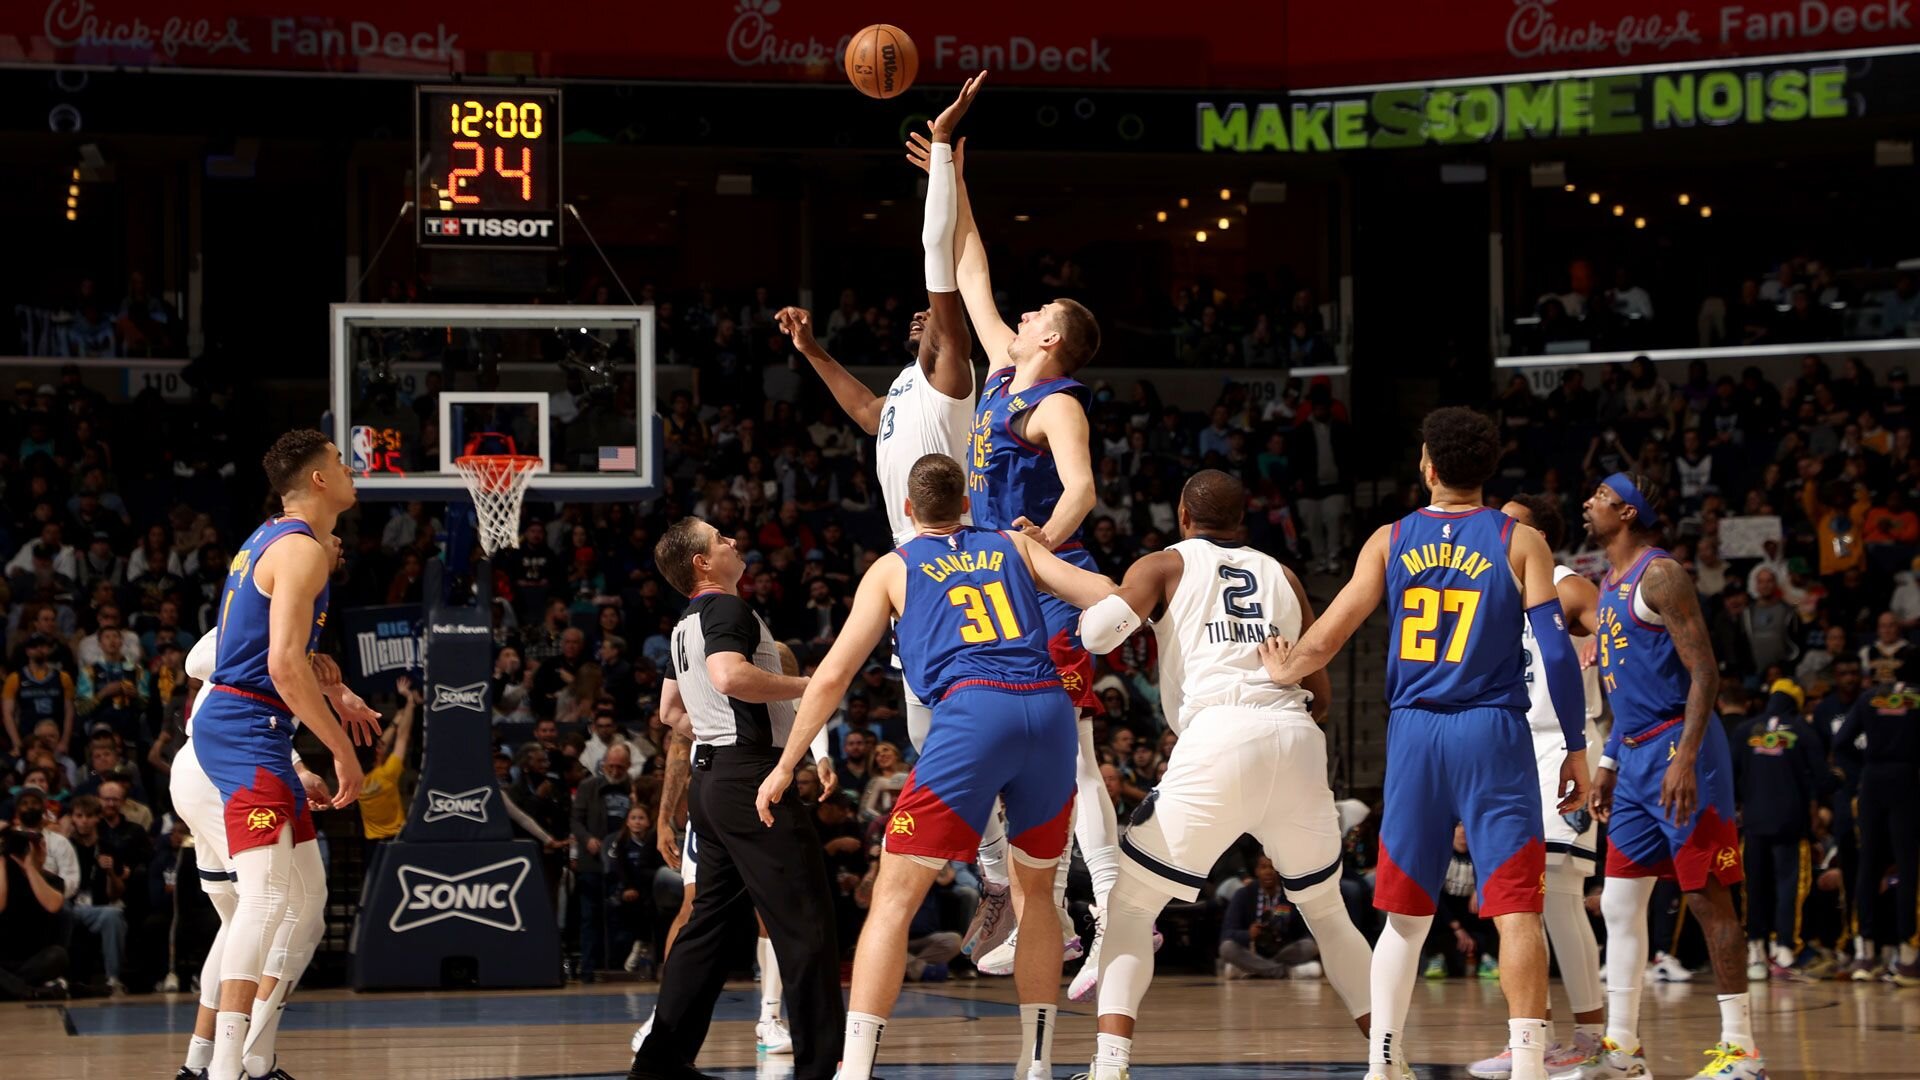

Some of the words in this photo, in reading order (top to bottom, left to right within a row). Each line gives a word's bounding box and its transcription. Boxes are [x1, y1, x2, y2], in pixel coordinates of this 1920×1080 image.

[270, 17, 460, 62] FanDeck
[1719, 0, 1905, 43] FanDeck
[882, 43, 898, 92] Wilson
[933, 34, 1112, 73] FanDeck
[451, 101, 543, 139] 12:00
[1196, 101, 1370, 152] MAKE
[1653, 65, 1849, 131] NOISE
[447, 141, 532, 205] 24
[460, 217, 554, 238] TISSOT
[974, 433, 985, 469] 15
[919, 550, 1004, 583] ČANČAR
[1400, 542, 1493, 580] MURRAY
[1218, 565, 1264, 619] 2
[377, 620, 411, 638] BIG
[947, 580, 1023, 644] 31
[1400, 586, 1482, 664] 27
[1205, 620, 1266, 645] TILLMAN
[677, 630, 690, 674] 16
[440, 691, 480, 704] SONIC
[433, 799, 481, 813] SONIC
[408, 883, 510, 910] SONIC
